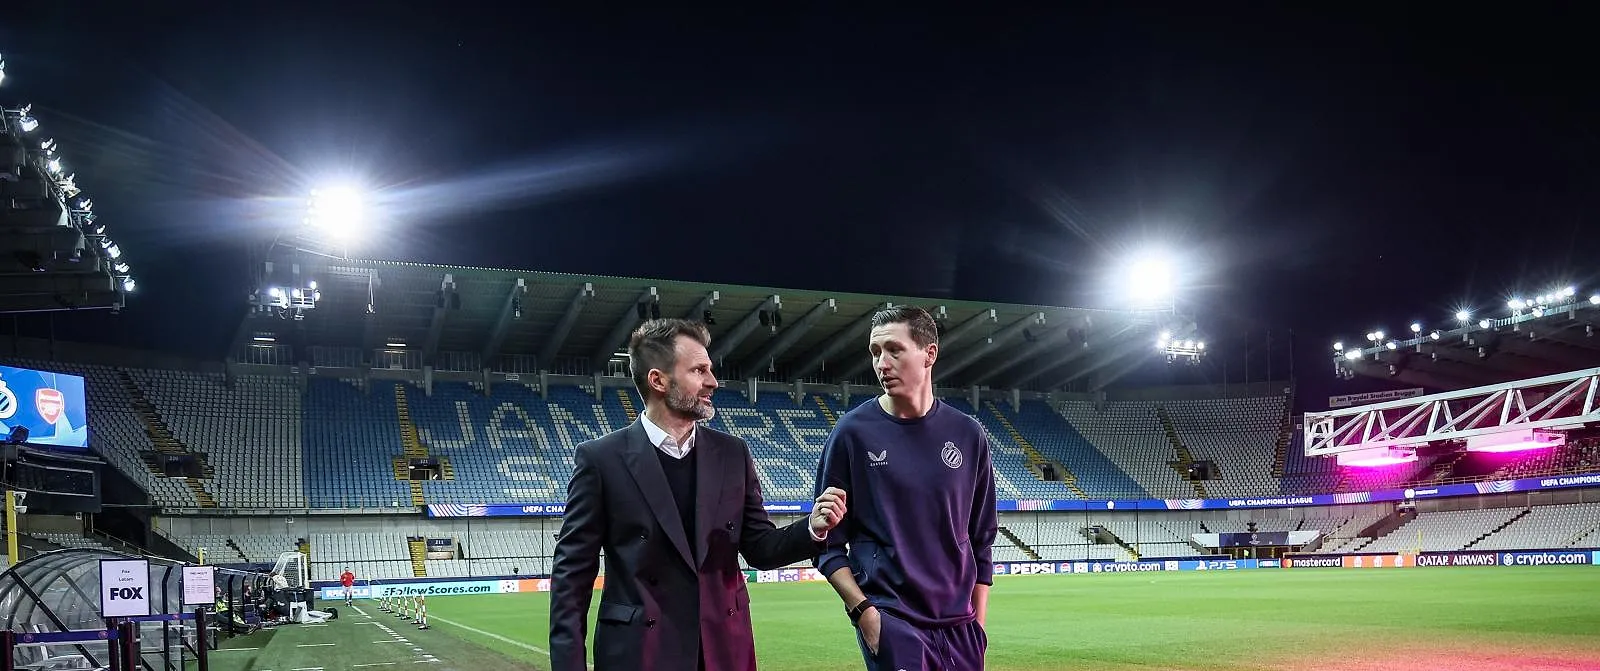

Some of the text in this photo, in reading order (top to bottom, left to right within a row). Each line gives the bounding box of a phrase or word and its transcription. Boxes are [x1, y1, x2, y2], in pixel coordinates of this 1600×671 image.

[1541, 475, 1600, 487] UEFA CHAMPIONS
[1246, 498, 1286, 506] CHAMPIONS
[522, 505, 543, 513] UEFA
[1293, 557, 1341, 567] mastercard
[1417, 554, 1494, 566] QATAR AIRWAYS
[1516, 552, 1586, 566] crypto.com
[1010, 562, 1056, 575] PEPSI
[1104, 561, 1161, 572] crypto.com
[1209, 561, 1237, 570] PS5
[778, 567, 815, 581] FedEx
[110, 586, 144, 600] FOX
